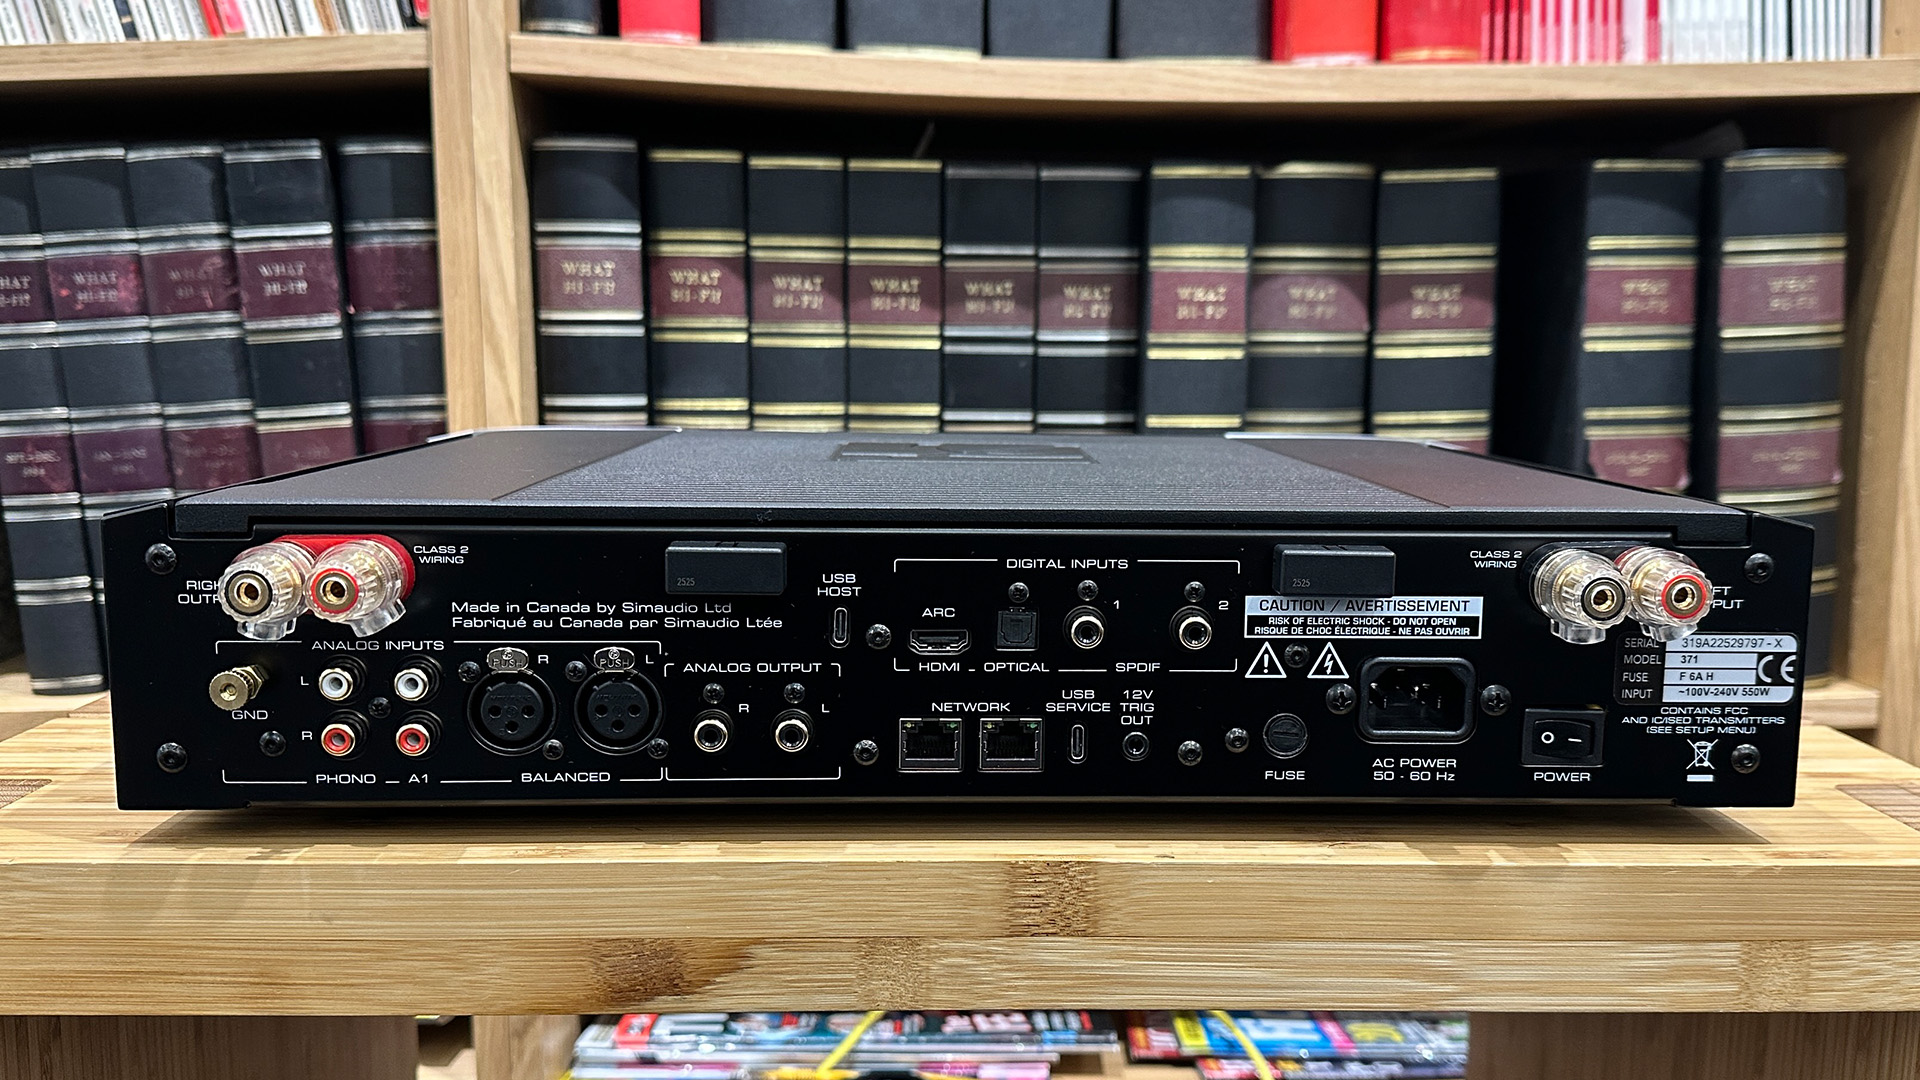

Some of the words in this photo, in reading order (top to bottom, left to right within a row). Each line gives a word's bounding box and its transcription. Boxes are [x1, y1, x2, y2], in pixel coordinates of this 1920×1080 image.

[1007, 559, 1065, 568] DIGITAL
[1072, 559, 1128, 569] INPUTS
[823, 574, 856, 583] USB
[186, 580, 220, 591] RIGH
[818, 587, 861, 596] HOST
[178, 594, 220, 604] OUTP
[452, 602, 499, 612] Made
[507, 602, 519, 612] in
[527, 602, 590, 612] Canada
[597, 603, 615, 615] by
[622, 602, 697, 613] Simaudio
[705, 603, 731, 613] Ltd
[1114, 600, 1119, 609] 1
[1219, 601, 1228, 610] 2
[1260, 600, 1325, 612] CAUTION
[1345, 600, 1470, 612] AVERTISSEMENT
[1712, 599, 1744, 609] PUT
[922, 608, 955, 617] ARC
[453, 617, 526, 629] Fabriqué
[560, 617, 622, 627] Canada
[630, 620, 658, 629] par
[665, 617, 739, 627] Simaudio
[747, 617, 782, 627] Ltée
[1268, 617, 1290, 625] RISK
[1293, 617, 1304, 625] OF
[1307, 617, 1350, 625] ELECTRIC
[1353, 617, 1385, 625] SHOCK
[1393, 617, 1405, 625] DO
[1409, 617, 1428, 625] NOT
[1431, 617, 1457, 625] OPEN
[1254, 627, 1288, 636] RISQUE
[1291, 627, 1304, 636] DE
[1306, 627, 1332, 635] CHOC
[1334, 625, 1391, 636] ÉLECTRIQUE
[1398, 627, 1412, 635] NE
[1414, 627, 1433, 635] PAS
[1435, 627, 1470, 635] OUVRIR
[312, 641, 379, 650] ANALOG
[386, 641, 444, 650] INPUTS
[1625, 638, 1659, 648] SERIAL
[1774, 638, 1783, 648] X
[493, 658, 524, 668] PUSH
[538, 655, 548, 664] R
[600, 658, 630, 668] PUSH
[646, 655, 654, 664] L
[1624, 654, 1662, 664] MODEL
[1680, 656, 1698, 664] 371
[683, 663, 750, 672] ANALOG
[757, 663, 822, 672] OUTPUT
[919, 663, 959, 671] HDMI
[984, 663, 1049, 671] OPTICAL
[1116, 663, 1160, 672] SPDIF
[301, 676, 309, 685] L
[1622, 672, 1649, 682] FUSE
[1679, 672, 1687, 681] F
[1689, 672, 1703, 681] 6A
[1705, 672, 1714, 681] H
[1062, 690, 1094, 699] USB
[1124, 690, 1153, 699] 12V
[1621, 689, 1653, 699] INPUT
[1678, 688, 1739, 697] ~100V-240V
[1741, 688, 1770, 696] 550W
[739, 704, 749, 712] R
[822, 704, 829, 712] L
[932, 703, 1010, 711] NETWORK
[1046, 703, 1110, 712] SERVICE
[1120, 703, 1154, 712] TRIG
[232, 710, 268, 719] GND
[1121, 716, 1153, 725] OUT
[302, 731, 312, 740] R
[1373, 759, 1394, 767] AC
[1400, 759, 1456, 768] POWER
[316, 774, 376, 783] PHONO
[409, 774, 427, 783] A1
[522, 772, 610, 782] BALANCED
[1265, 771, 1305, 780] FUSE
[1374, 771, 1394, 780] 50
[1410, 772, 1430, 780] 60
[1437, 772, 1455, 780] Hz
[1534, 772, 1590, 781] POWER
